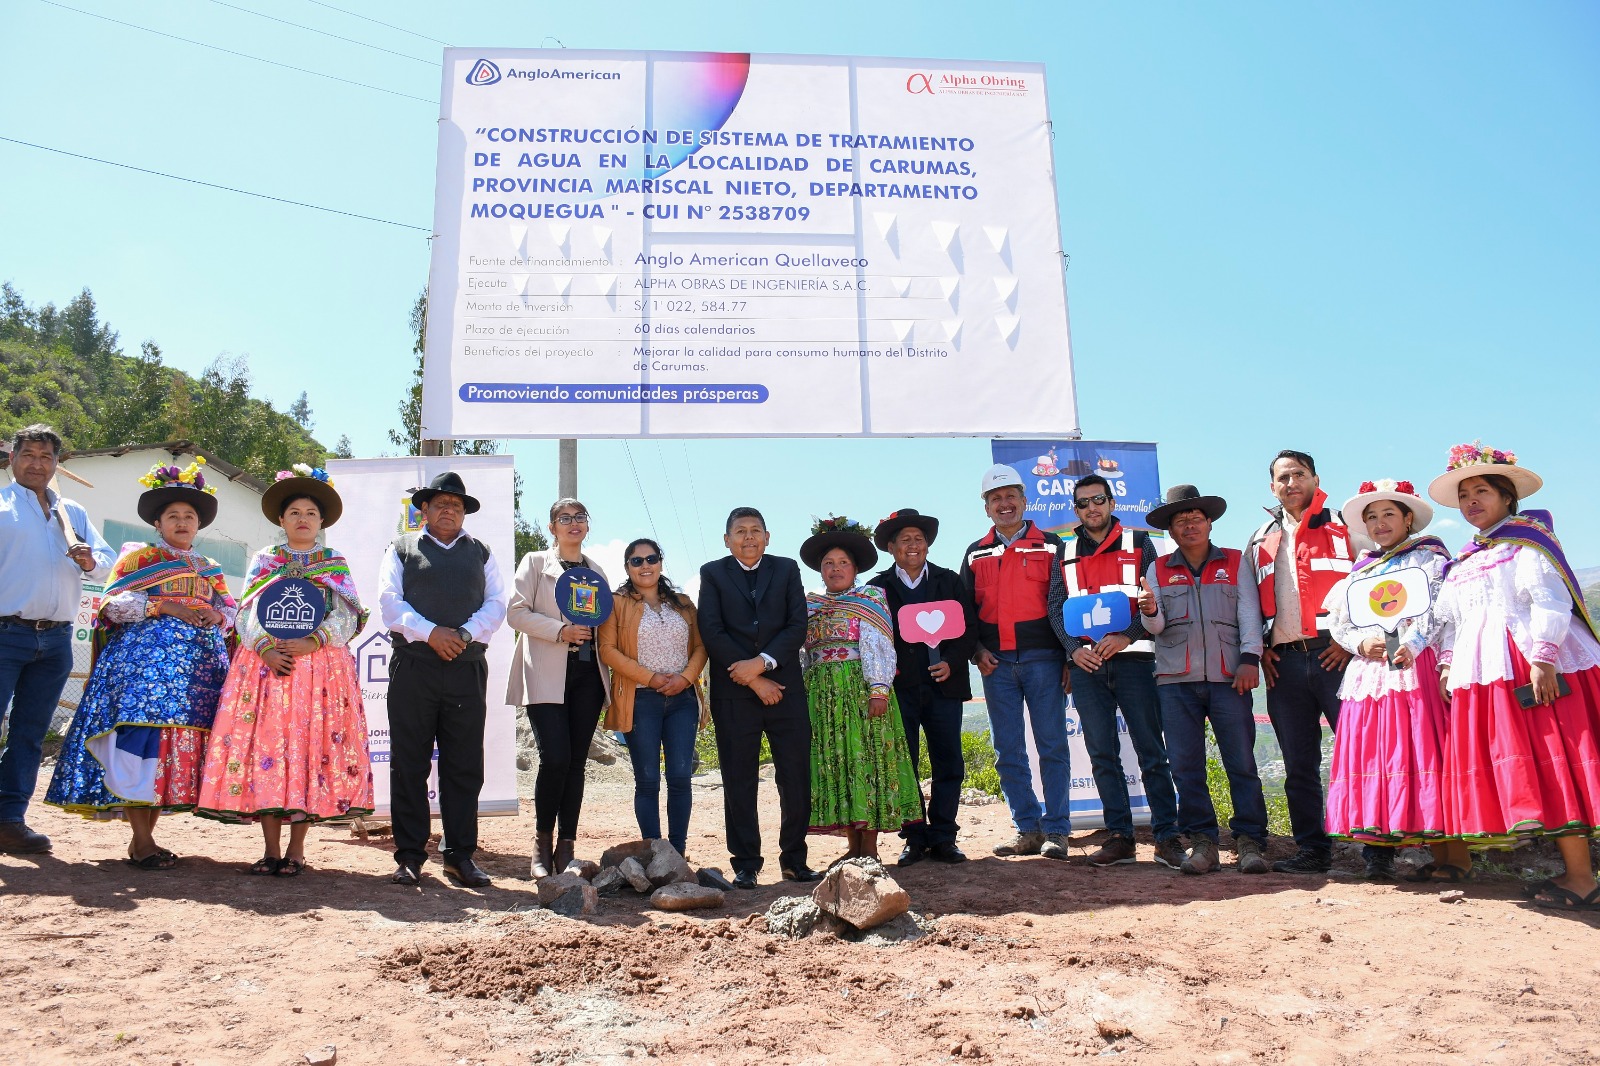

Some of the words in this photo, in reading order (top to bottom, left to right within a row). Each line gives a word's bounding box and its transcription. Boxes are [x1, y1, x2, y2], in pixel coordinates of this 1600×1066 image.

[507, 68, 620, 81] AngloAmerican
[940, 74, 977, 86] Alpha
[981, 76, 1025, 88] Obring
[666, 130, 692, 145] DE
[699, 130, 788, 147] SISTEMA
[796, 133, 821, 147] DE
[830, 134, 974, 152] TRATAMIENTO
[474, 153, 500, 167] DE
[518, 153, 581, 168] AGUA
[600, 154, 627, 168] EN
[646, 155, 670, 169] LA
[689, 155, 808, 171] LOCALIDAD
[827, 158, 853, 172] DE
[870, 159, 977, 178] CARUMAS,
[473, 178, 593, 193] PROVINCIA
[606, 179, 713, 194] MARISCAL
[726, 181, 797, 198] NIETO,
[810, 182, 978, 200] DEPARTAMENTO
[471, 203, 604, 220] MOQUEGUA
[643, 205, 678, 219] CUI
[719, 205, 810, 221] 2538709
[469, 256, 505, 266] Fuente
[510, 257, 523, 266] de
[527, 256, 609, 266] financiamiento
[635, 253, 684, 269] Anglo
[690, 253, 768, 266] American
[776, 253, 869, 268] Quellaveco
[468, 278, 507, 290] Ejecuta
[634, 278, 677, 289] ALPHA
[682, 279, 726, 290] OBRAS
[730, 279, 747, 289] DE
[752, 277, 828, 291] INGENIERÍA
[832, 280, 871, 291] S.A.C.
[506, 301, 520, 311] de
[524, 300, 573, 312] inversión
[634, 300, 648, 312] S/
[667, 301, 696, 314] 022,
[701, 301, 746, 312] 584.77
[465, 325, 496, 335] Plazo
[499, 325, 513, 335] de
[517, 324, 570, 337] ejecución
[634, 324, 650, 334] 60
[684, 325, 755, 335] calendarios
[464, 346, 520, 356] Beneficios
[524, 346, 541, 356] del
[545, 347, 594, 359] proyecto
[634, 347, 680, 359] Mejorar
[684, 347, 694, 357] la
[698, 347, 741, 357] calidad
[746, 349, 771, 359] para
[776, 350, 828, 358] consumo
[833, 347, 881, 358] humano
[885, 347, 903, 358] del
[907, 348, 948, 358] Distrito
[634, 361, 648, 371] de
[652, 362, 708, 371] Carumas.
[468, 386, 569, 400] Promoviendo
[575, 387, 678, 400] comunidades
[683, 387, 759, 403] prósperas
[1049, 503, 1066, 517] por
[1114, 500, 1152, 512] esarrollo!
